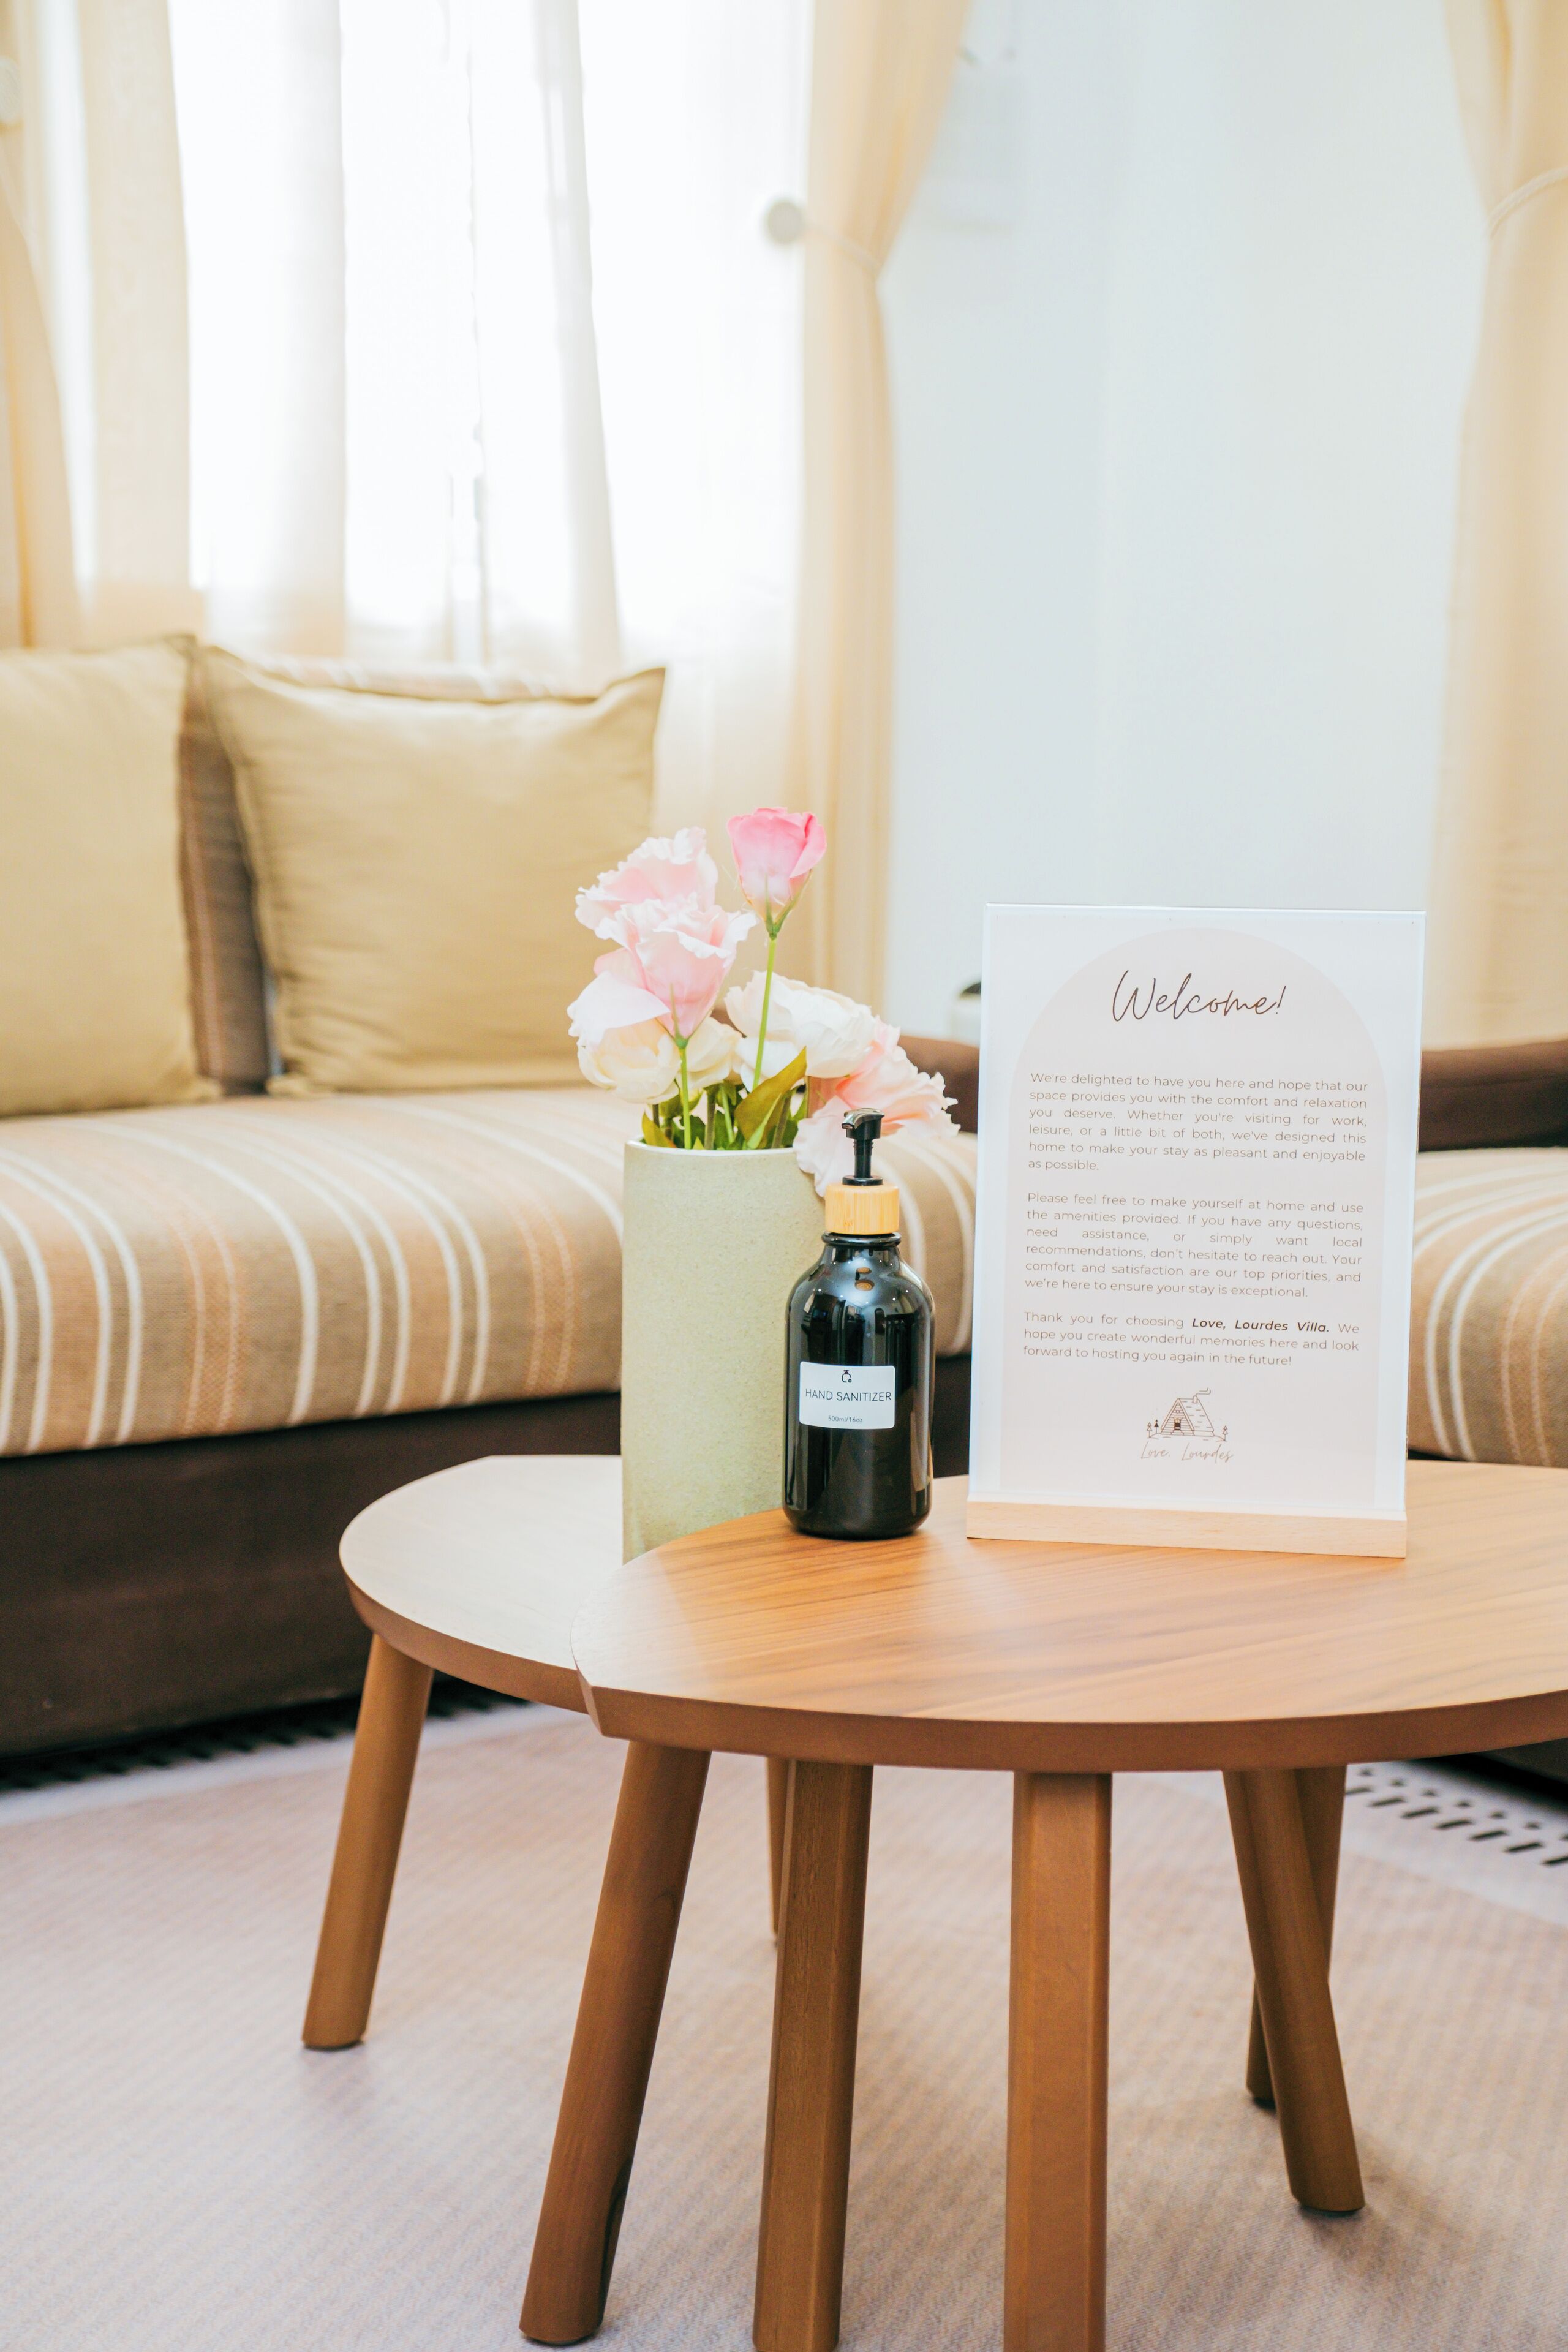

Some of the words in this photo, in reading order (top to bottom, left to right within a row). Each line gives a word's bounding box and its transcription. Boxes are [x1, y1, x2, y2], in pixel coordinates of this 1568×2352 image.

[1112, 970, 1287, 1021] Welcome!
[1031, 1073, 1067, 1083] We're
[1071, 1074, 1132, 1087] delighted
[1137, 1076, 1149, 1085] to
[1155, 1076, 1184, 1087] have
[1188, 1079, 1210, 1089] you
[1216, 1078, 1245, 1088] here
[1250, 1079, 1273, 1088] and
[1279, 1079, 1311, 1091] hope
[1315, 1080, 1342, 1090] that
[1030, 1092, 1066, 1102] space
[1072, 1091, 1125, 1102] provides
[1129, 1095, 1152, 1104] you
[1158, 1093, 1186, 1104] with
[1191, 1095, 1212, 1104] the
[1218, 1096, 1268, 1106] comfort
[1274, 1097, 1298, 1107] and
[1304, 1098, 1366, 1109] relaxation
[1029, 1109, 1052, 1119] you
[1064, 1108, 1115, 1119] deserve.
[1127, 1110, 1183, 1120] Whether
[1194, 1113, 1234, 1124] you're
[1245, 1113, 1291, 1126] visiting
[1303, 1114, 1320, 1125] for
[1332, 1116, 1366, 1127] work,
[1030, 1124, 1072, 1136] leisure,
[1115, 1126, 1142, 1137] little
[1150, 1127, 1166, 1137] bit
[1173, 1128, 1186, 1138] of
[1193, 1128, 1224, 1141] both,
[1232, 1131, 1268, 1140] we've
[1275, 1131, 1335, 1144] designed
[1343, 1133, 1366, 1143] this
[1030, 1142, 1065, 1152] home
[1071, 1144, 1083, 1152] to
[1090, 1144, 1124, 1153] make
[1129, 1147, 1158, 1156] your
[1163, 1147, 1189, 1158] stay
[1213, 1147, 1267, 1159] pleasant
[1273, 1149, 1297, 1159] and
[1303, 1150, 1365, 1163] enjoyable
[1046, 1159, 1099, 1171] possible.
[1028, 1193, 1068, 1203] Please
[1074, 1194, 1096, 1204] feel
[1102, 1194, 1126, 1205] free
[1132, 1197, 1145, 1205] to
[1152, 1197, 1186, 1207] make
[1192, 1199, 1243, 1210] yourself
[1248, 1200, 1261, 1209] at
[1267, 1200, 1305, 1211] home
[1311, 1202, 1335, 1212] and
[1027, 1209, 1047, 1219] the
[1054, 1212, 1116, 1222] amenities
[1123, 1213, 1181, 1224] provided.
[1188, 1215, 1196, 1224] If
[1201, 1218, 1224, 1227] you
[1232, 1216, 1261, 1227] have
[1268, 1220, 1291, 1230] any
[1297, 1219, 1362, 1231] questions,
[1027, 1227, 1057, 1237] need
[1082, 1229, 1149, 1242] assistance,
[1210, 1233, 1252, 1246] simply
[1276, 1237, 1308, 1246] want
[1333, 1237, 1362, 1247] local
[1027, 1246, 1145, 1259] recommendations,
[1150, 1248, 1183, 1259] don't
[1189, 1250, 1239, 1261] hesitate
[1244, 1252, 1257, 1261] to
[1262, 1253, 1297, 1262] reach
[1303, 1254, 1327, 1264] out.
[1332, 1254, 1362, 1264] Your
[1026, 1262, 1075, 1272] comfort
[1082, 1264, 1105, 1273] and
[1112, 1264, 1183, 1276] satisfaction
[1243, 1269, 1265, 1281] top
[1272, 1270, 1330, 1283] priorities,
[1336, 1272, 1361, 1282] and
[1025, 1278, 1058, 1288] we're
[1063, 1279, 1090, 1289] here
[1094, 1281, 1106, 1290] to
[1110, 1283, 1153, 1292] ensure
[1156, 1284, 1185, 1294] your
[1189, 1284, 1215, 1296] stay
[1219, 1284, 1227, 1294] is
[1231, 1286, 1308, 1298] exceptional.
[1024, 1311, 1063, 1322] Thank
[1070, 1316, 1093, 1325] you
[1101, 1314, 1118, 1324] for
[1126, 1315, 1183, 1329] choosing
[1191, 1318, 1226, 1330] Love,
[1235, 1319, 1289, 1331] Lourdes
[1297, 1321, 1329, 1333] Villa.
[1338, 1323, 1359, 1333] We
[1025, 1328, 1055, 1341] hope
[1060, 1333, 1082, 1342] you
[1087, 1333, 1126, 1341] create
[1131, 1334, 1195, 1344] wonderful
[1201, 1336, 1265, 1347] memories
[1270, 1338, 1298, 1348] here
[1303, 1340, 1327, 1349] and
[1332, 1340, 1359, 1351] look
[1024, 1346, 1071, 1357] forward
[1076, 1348, 1088, 1357] to
[1093, 1348, 1139, 1362] hosting
[1143, 1352, 1166, 1362] you
[1170, 1352, 1205, 1364] again
[1209, 1353, 1219, 1362] in
[1224, 1354, 1245, 1364] the
[1249, 1354, 1291, 1365] future!
[805, 1388, 833, 1400] HAND
[836, 1392, 892, 1401] SANITIZER
[1182, 1442, 1234, 1464] Lourdes
